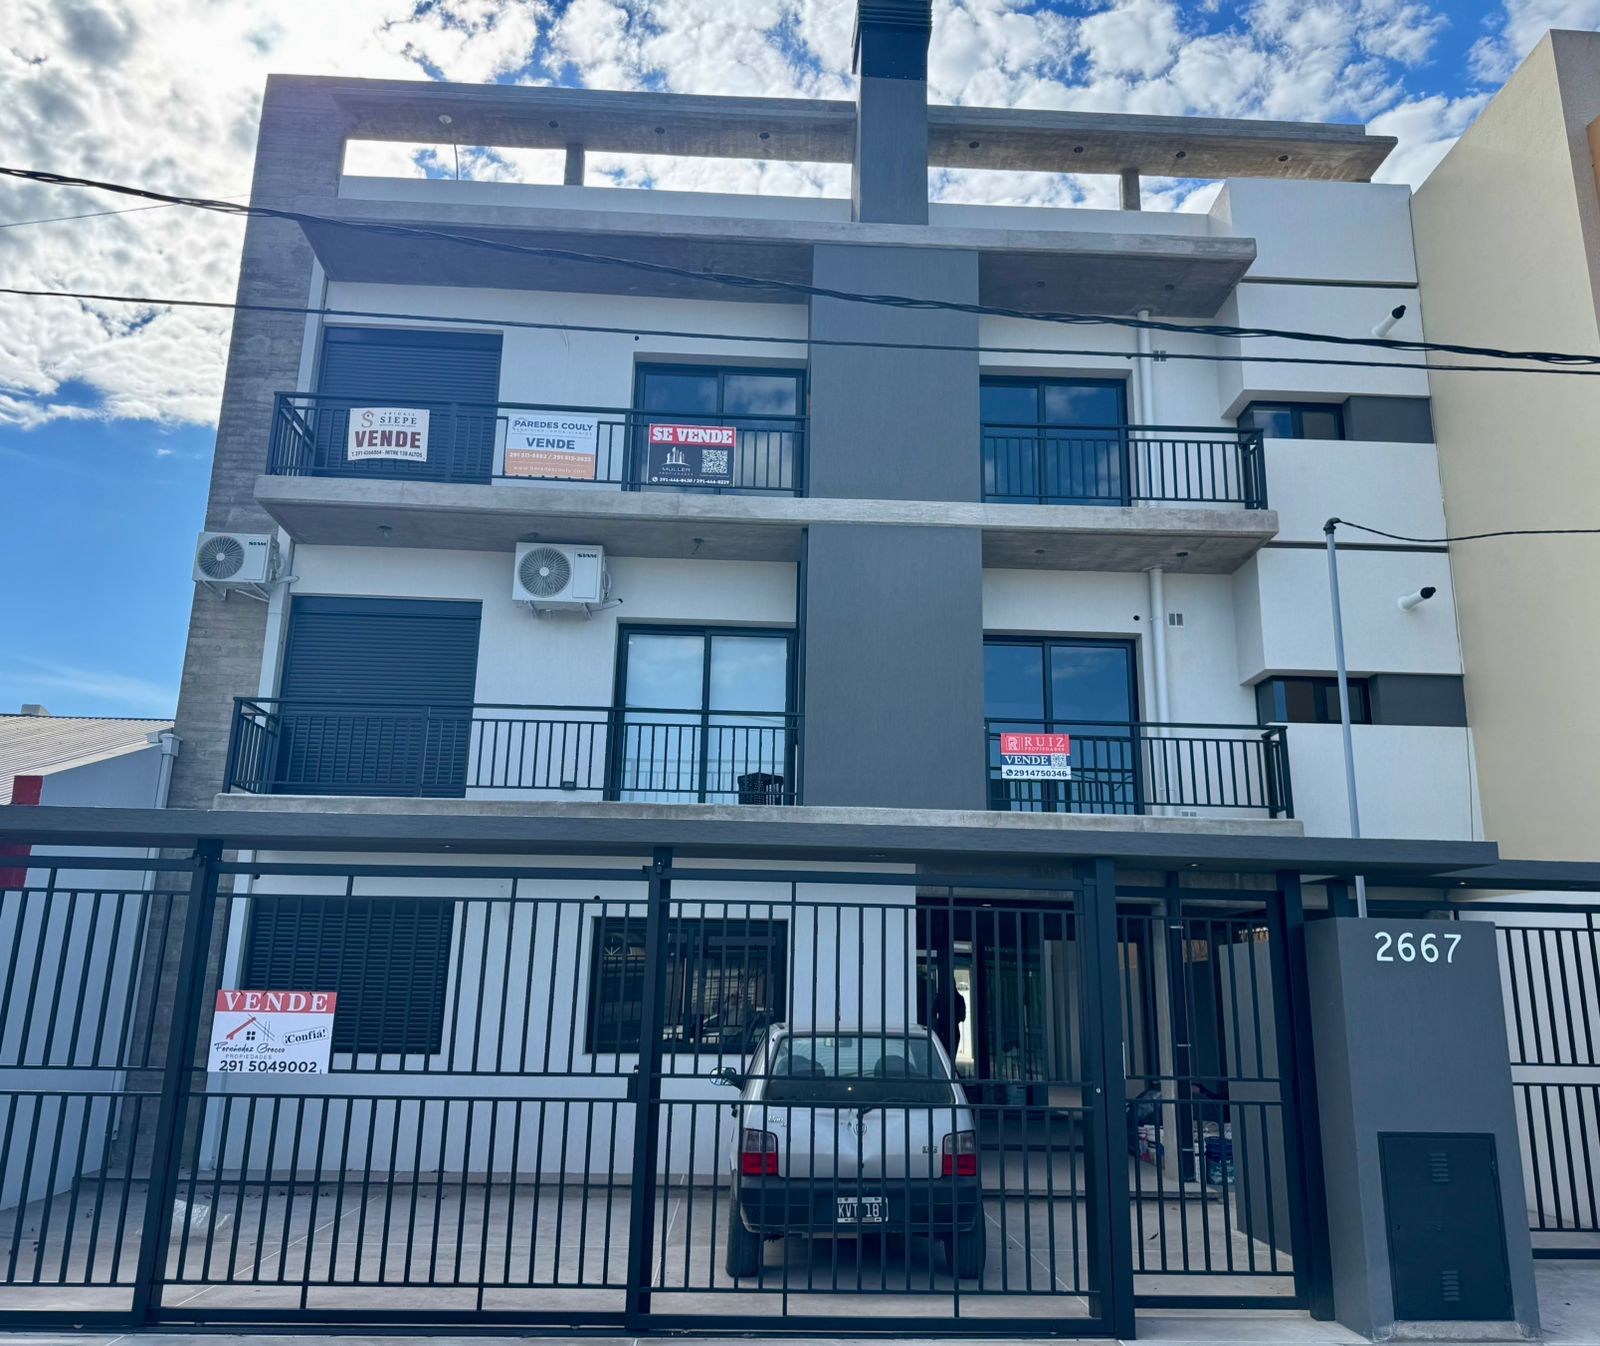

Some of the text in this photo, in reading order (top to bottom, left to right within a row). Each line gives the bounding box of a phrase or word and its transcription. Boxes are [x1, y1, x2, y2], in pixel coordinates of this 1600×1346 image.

[379, 416, 417, 425] SIEPE
[514, 420, 594, 431] PAREDES COULY
[355, 430, 421, 448] VENDE
[652, 427, 733, 444] SE VENDE
[526, 437, 576, 450] VENDE
[1024, 736, 1065, 748] RUIZ
[1005, 755, 1049, 765] VENDE
[1014, 769, 1067, 777] 2914750346
[1374, 931, 1462, 964] 2667
[224, 991, 329, 1012] VENDE
[219, 1060, 317, 1073] 291 5049002
[838, 1203, 882, 1217] KVT 18
